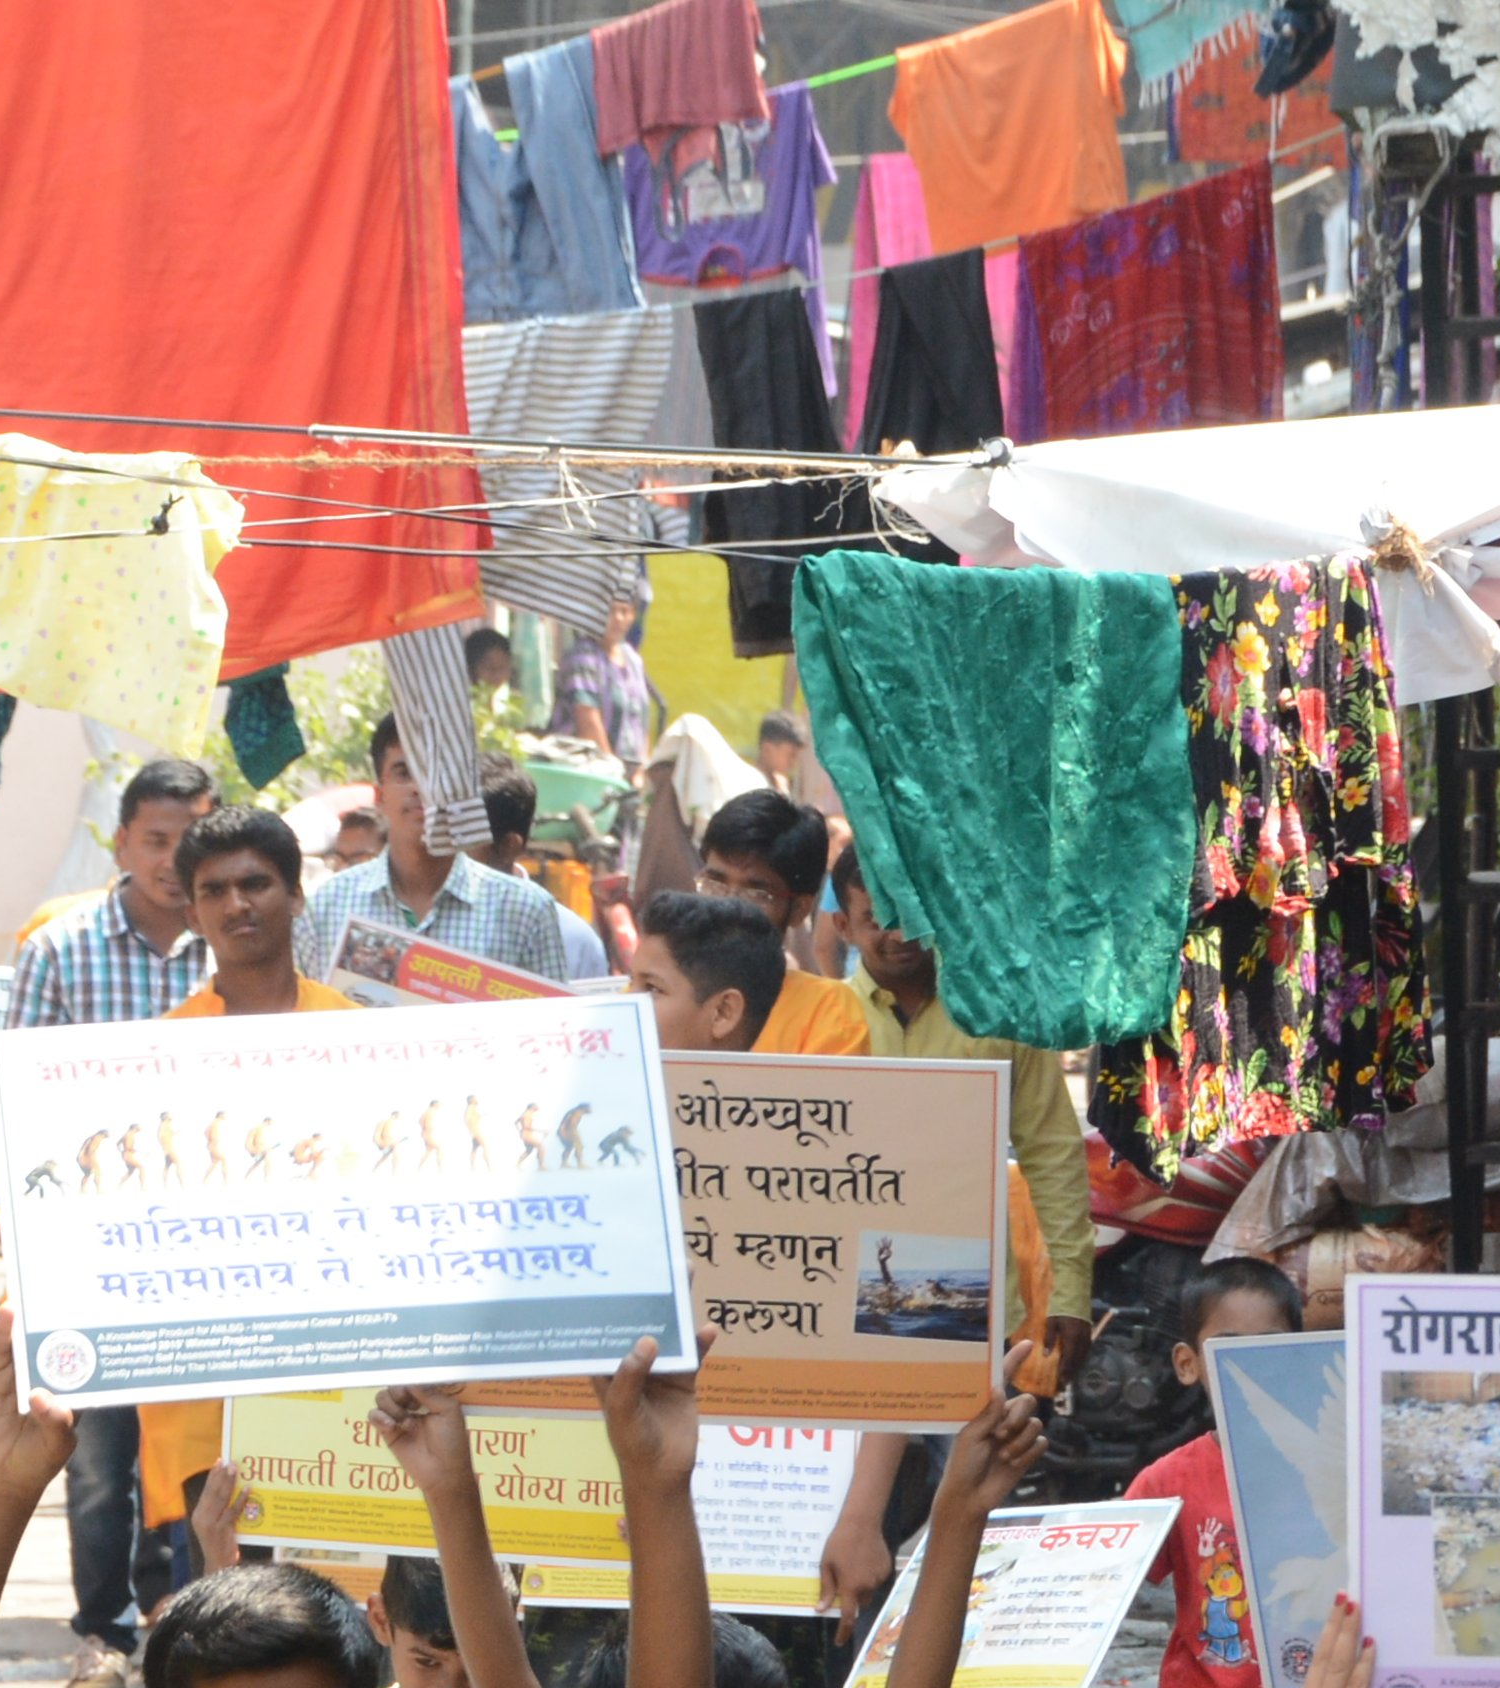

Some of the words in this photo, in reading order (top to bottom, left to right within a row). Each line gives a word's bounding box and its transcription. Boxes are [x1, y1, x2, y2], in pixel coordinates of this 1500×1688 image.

[675, 1079, 853, 1149] ओळखूया
[745, 1153, 906, 1207] परावर्तीत
[97, 1203, 316, 1251] आदिमानव
[331, 1189, 369, 1234] ते
[391, 1191, 602, 1231] महामानव
[97, 1261, 301, 1305] महामानव
[319, 1247, 354, 1289] ते
[384, 1238, 610, 1284] आदिमानव
[735, 1234, 844, 1284] म्हणून
[240, 1449, 337, 1488] आपत्ती
[495, 1464, 567, 1504] योग्य
[1039, 1521, 1140, 1551] कचरा
